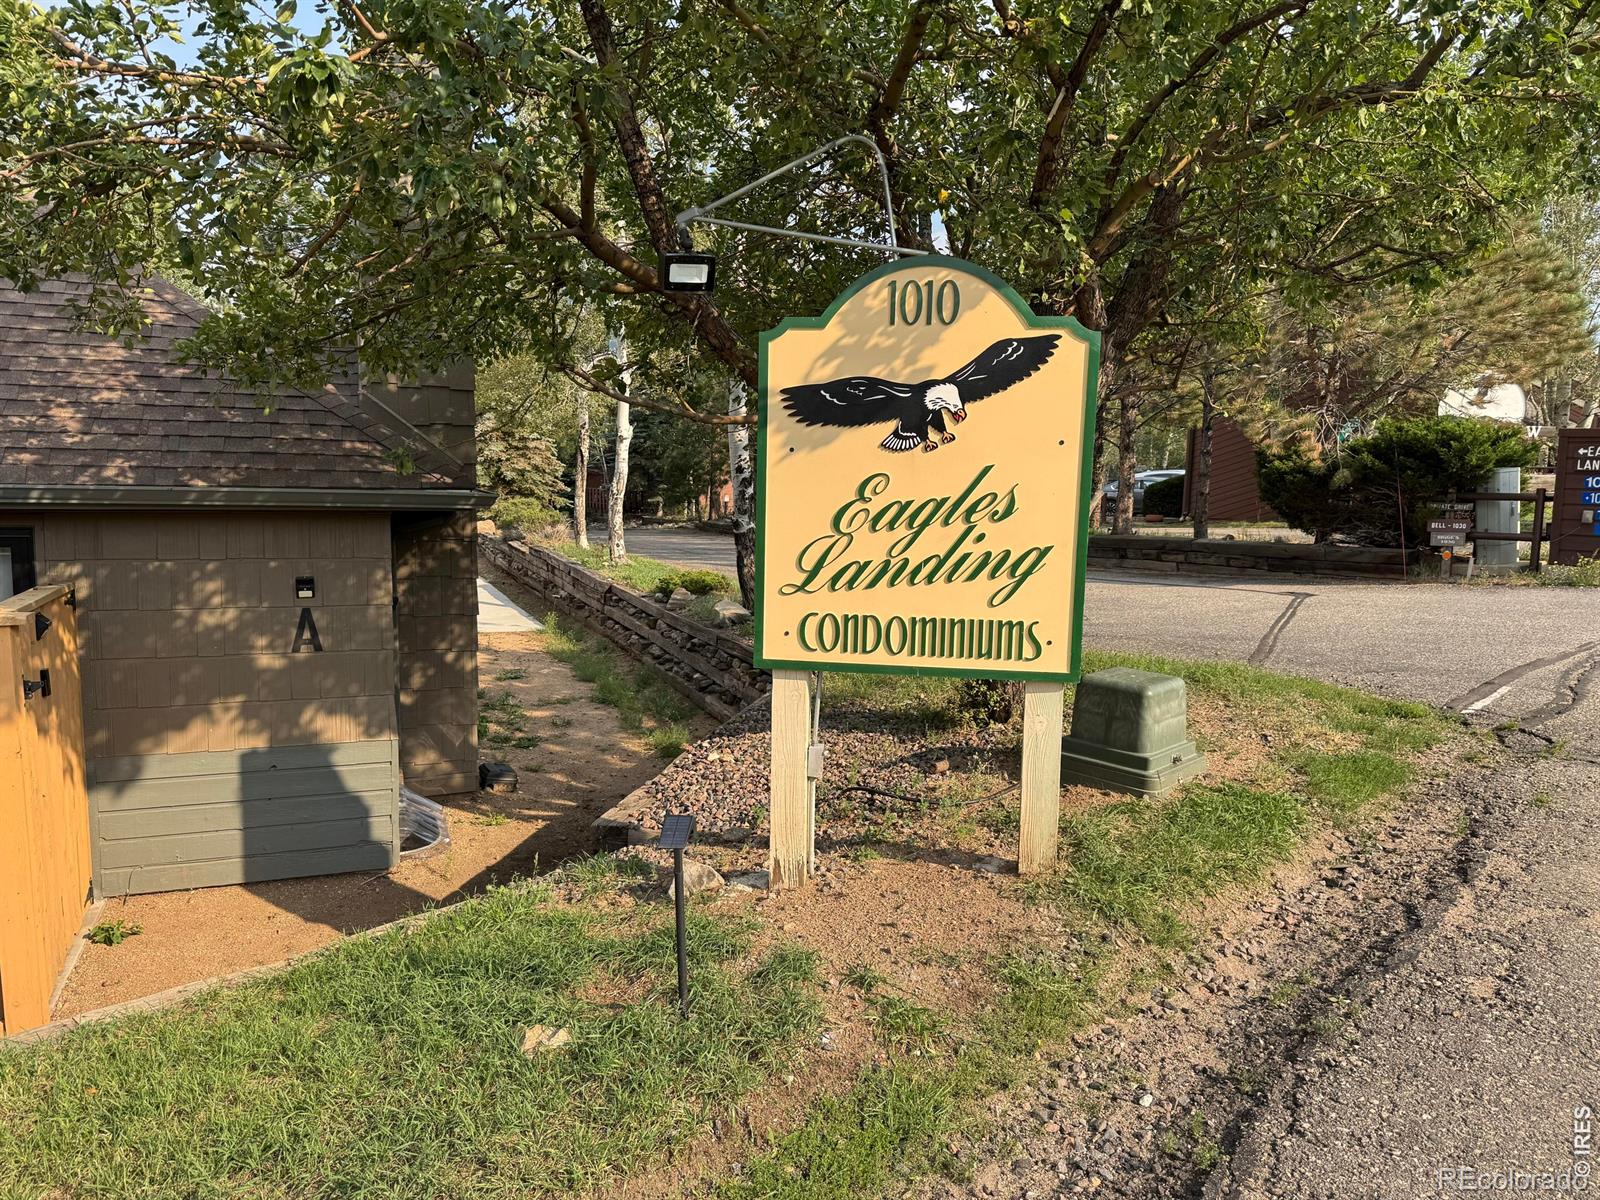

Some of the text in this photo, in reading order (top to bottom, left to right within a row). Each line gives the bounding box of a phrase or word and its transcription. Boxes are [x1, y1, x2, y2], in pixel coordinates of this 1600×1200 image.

[887, 279, 961, 327] 1010
[831, 464, 1020, 555] Eagles
[778, 526, 1055, 607] Landing
[291, 607, 324, 654] A
